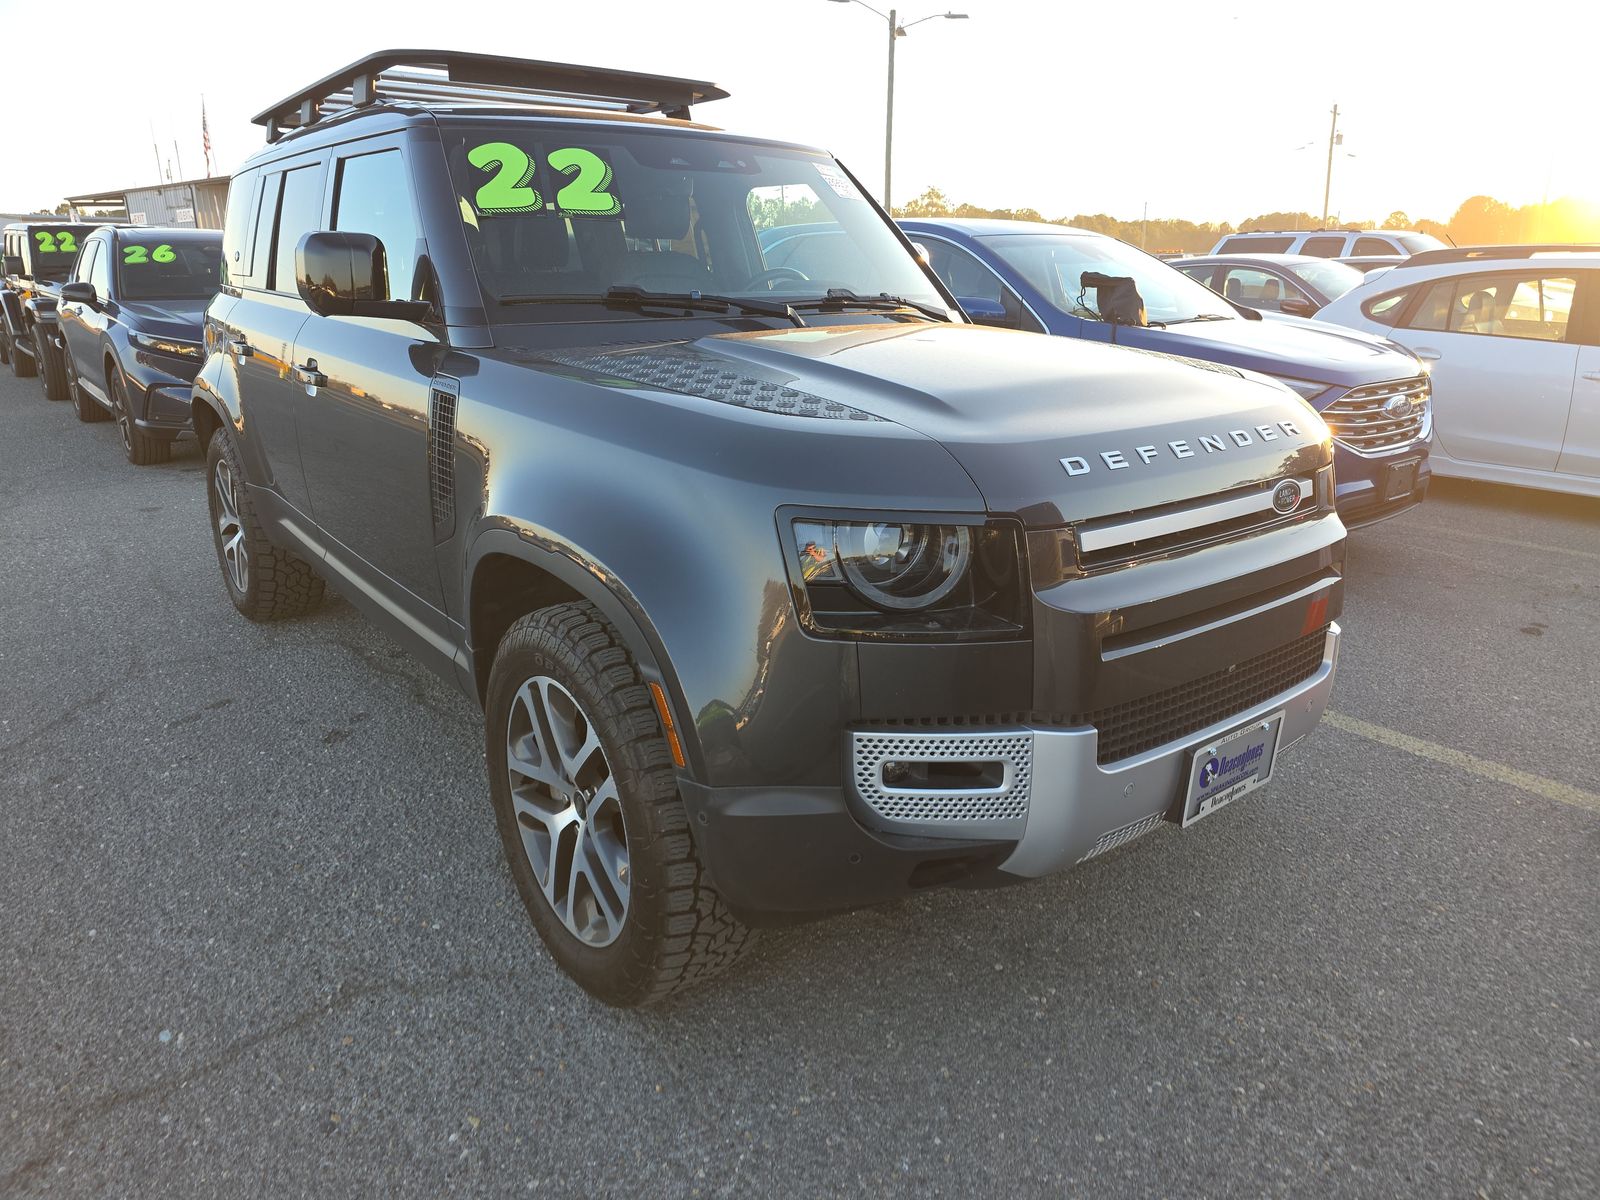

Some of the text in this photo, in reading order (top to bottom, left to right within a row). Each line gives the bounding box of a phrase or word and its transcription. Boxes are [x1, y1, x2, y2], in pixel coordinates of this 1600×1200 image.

[35, 231, 79, 252] 22
[122, 245, 177, 264] 26
[1059, 420, 1301, 477] DEFENDER
